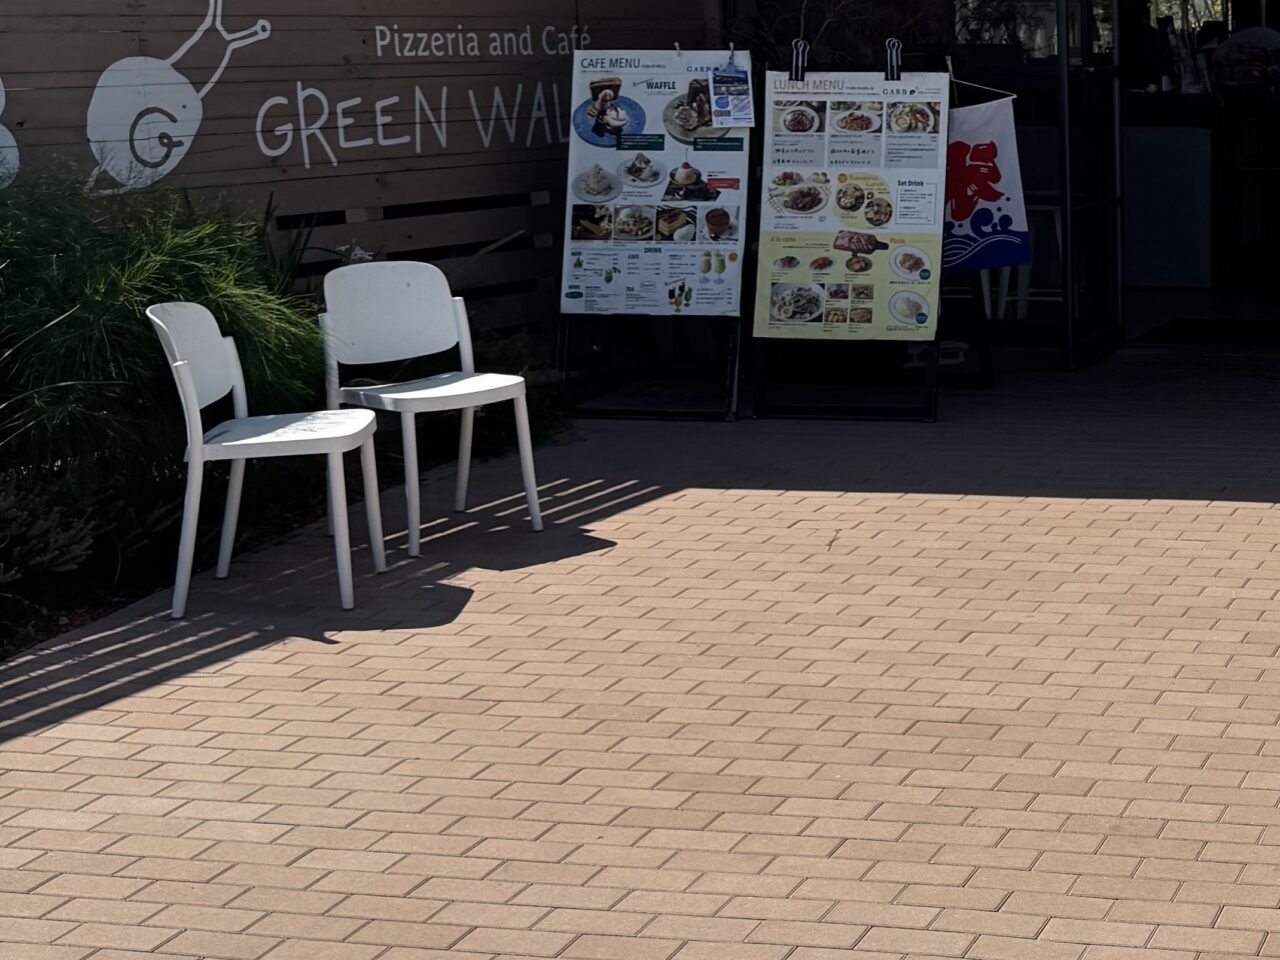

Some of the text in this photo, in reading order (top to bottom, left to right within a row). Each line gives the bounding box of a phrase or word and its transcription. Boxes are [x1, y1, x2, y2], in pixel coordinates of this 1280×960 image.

[375, 24, 591, 57] Pizzeria and Café
[581, 58, 640, 68] CAFE MENU
[647, 82, 676, 90] WAFFLE
[774, 79, 809, 90] LUNCH
[813, 80, 844, 90] MENU
[256, 81, 571, 169] GREEN WAL
